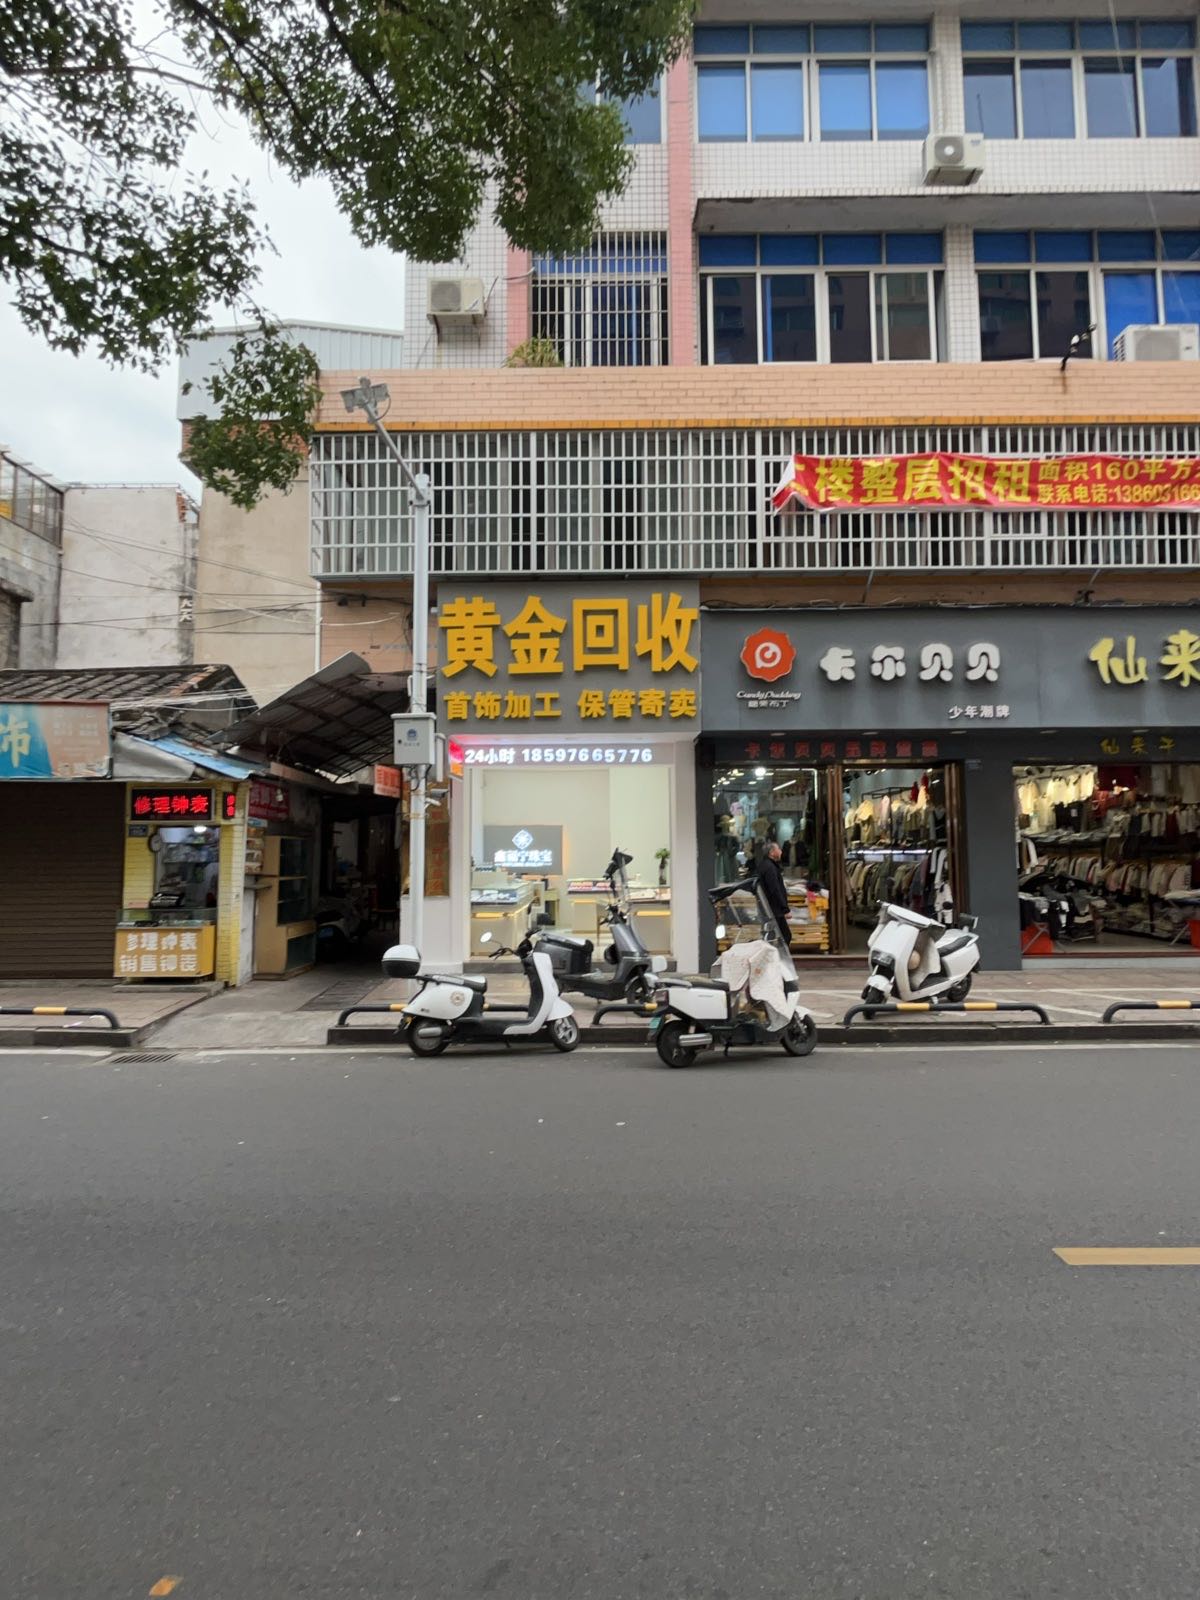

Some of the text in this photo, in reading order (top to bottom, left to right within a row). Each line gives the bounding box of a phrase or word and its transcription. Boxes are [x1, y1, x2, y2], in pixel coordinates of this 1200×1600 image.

[1039, 459, 1200, 481] 面积160平方
[438, 592, 699, 678] 黄金回收
[819, 643, 1000, 682] 卡尔贝贝
[444, 688, 698, 720] 首饰加工 保管寄卖
[464, 748, 653, 765] 24小时 18597665776
